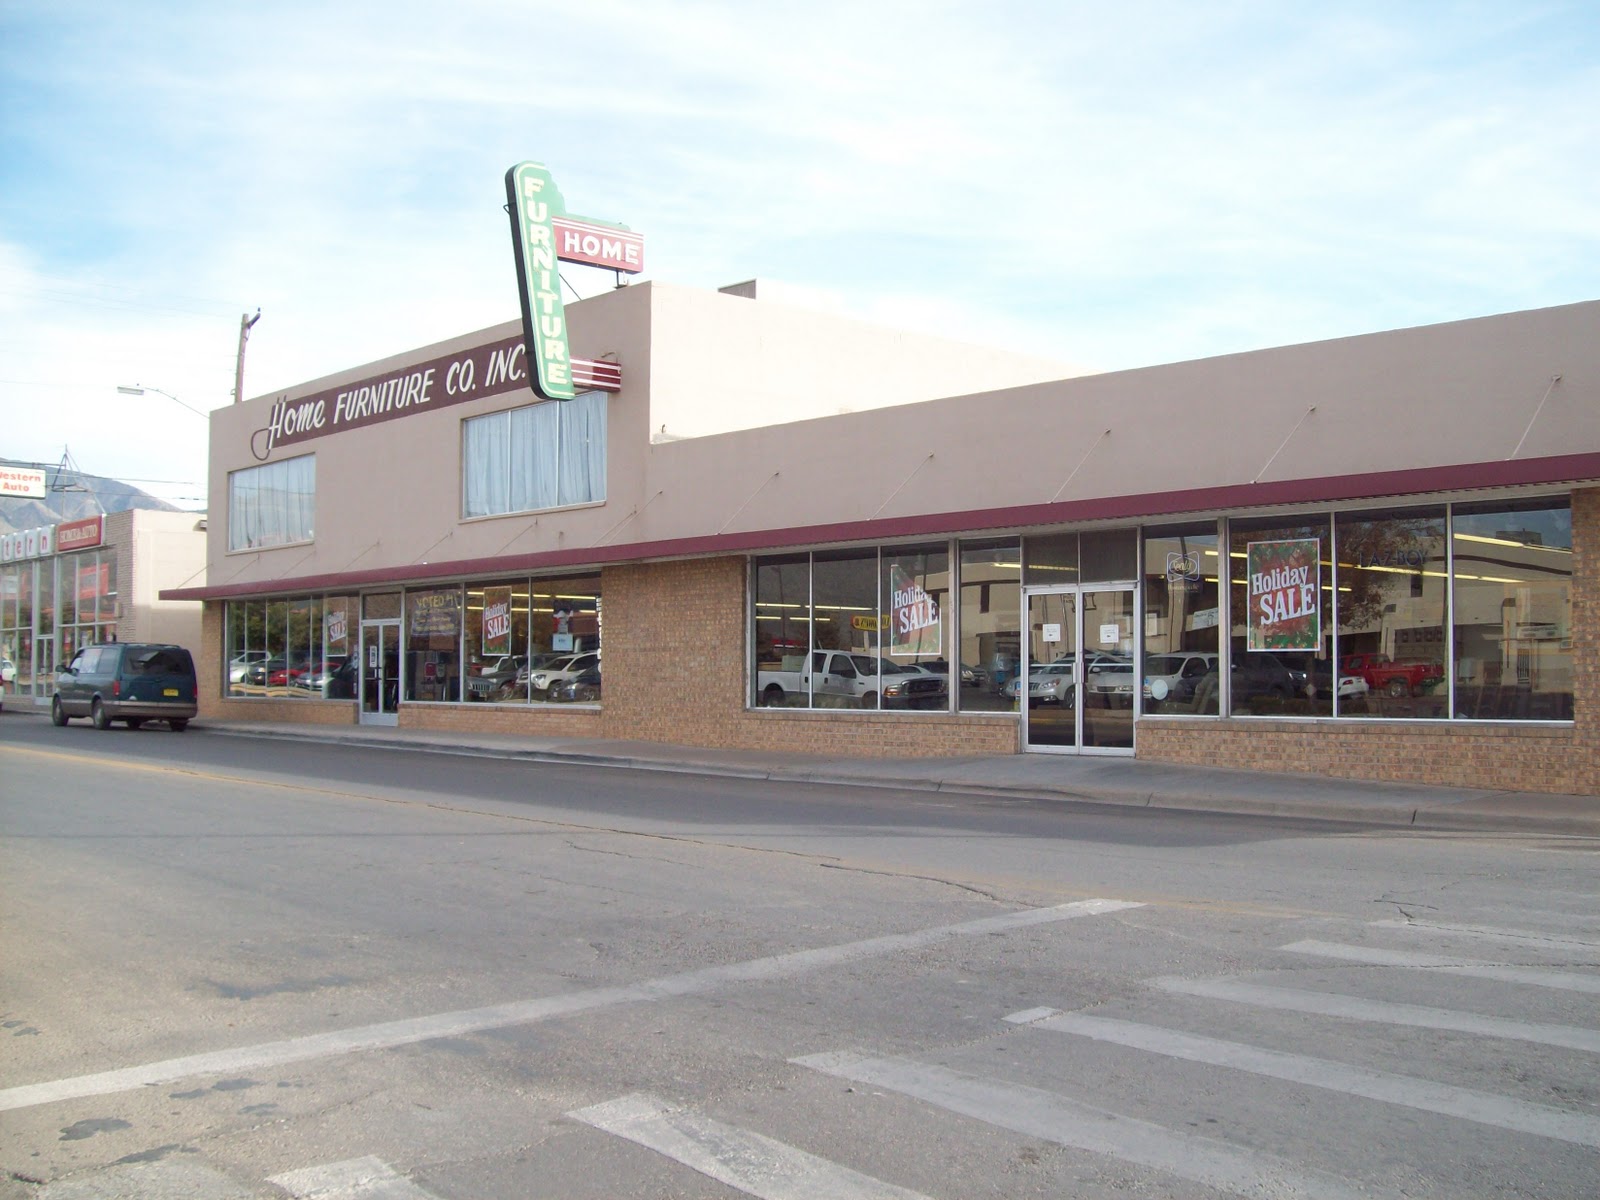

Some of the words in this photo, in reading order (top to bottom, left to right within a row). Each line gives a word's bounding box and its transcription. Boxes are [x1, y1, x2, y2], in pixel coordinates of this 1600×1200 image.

[564, 230, 640, 265] HOME
[524, 176, 568, 385] FURNITURE
[251, 396, 325, 460] Home
[333, 368, 436, 424] FURNITURE
[446, 358, 476, 395] CO.
[484, 343, 527, 388] INC.
[3, 482, 30, 492] Auto
[1251, 565, 1309, 595] Holiday
[485, 602, 508, 620] Holiday
[900, 599, 939, 634] SALE
[1260, 583, 1316, 625] SALE
[487, 614, 510, 640] SALE
